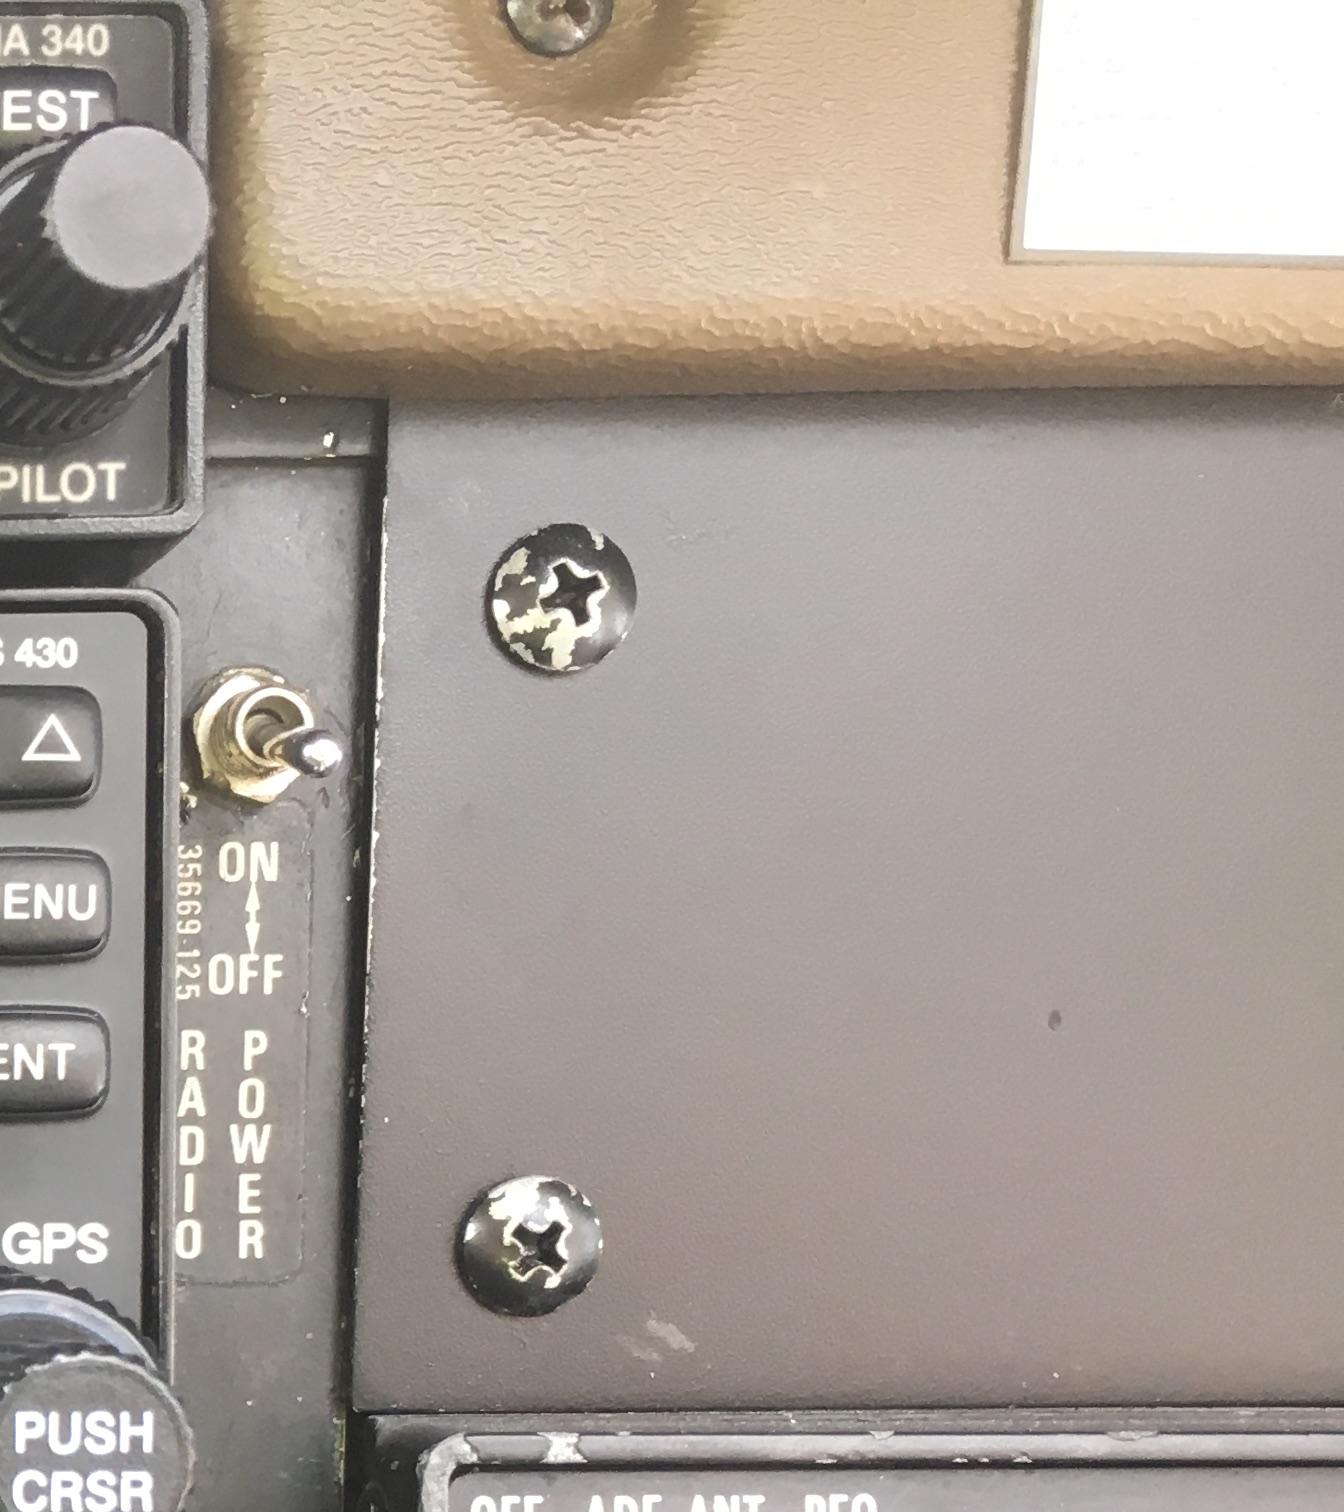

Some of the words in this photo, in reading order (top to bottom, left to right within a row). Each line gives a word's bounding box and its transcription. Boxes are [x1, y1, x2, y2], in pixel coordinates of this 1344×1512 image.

[40, 22, 110, 58] 340
[13, 636, 79, 669] 430
[218, 841, 280, 883] ON
[207, 953, 285, 996] OFF
[174, 1028, 208, 1262] RADIO
[228, 1028, 272, 1260] POWER
[1, 1221, 110, 1265] GPS
[14, 1410, 155, 1456] PUSH
